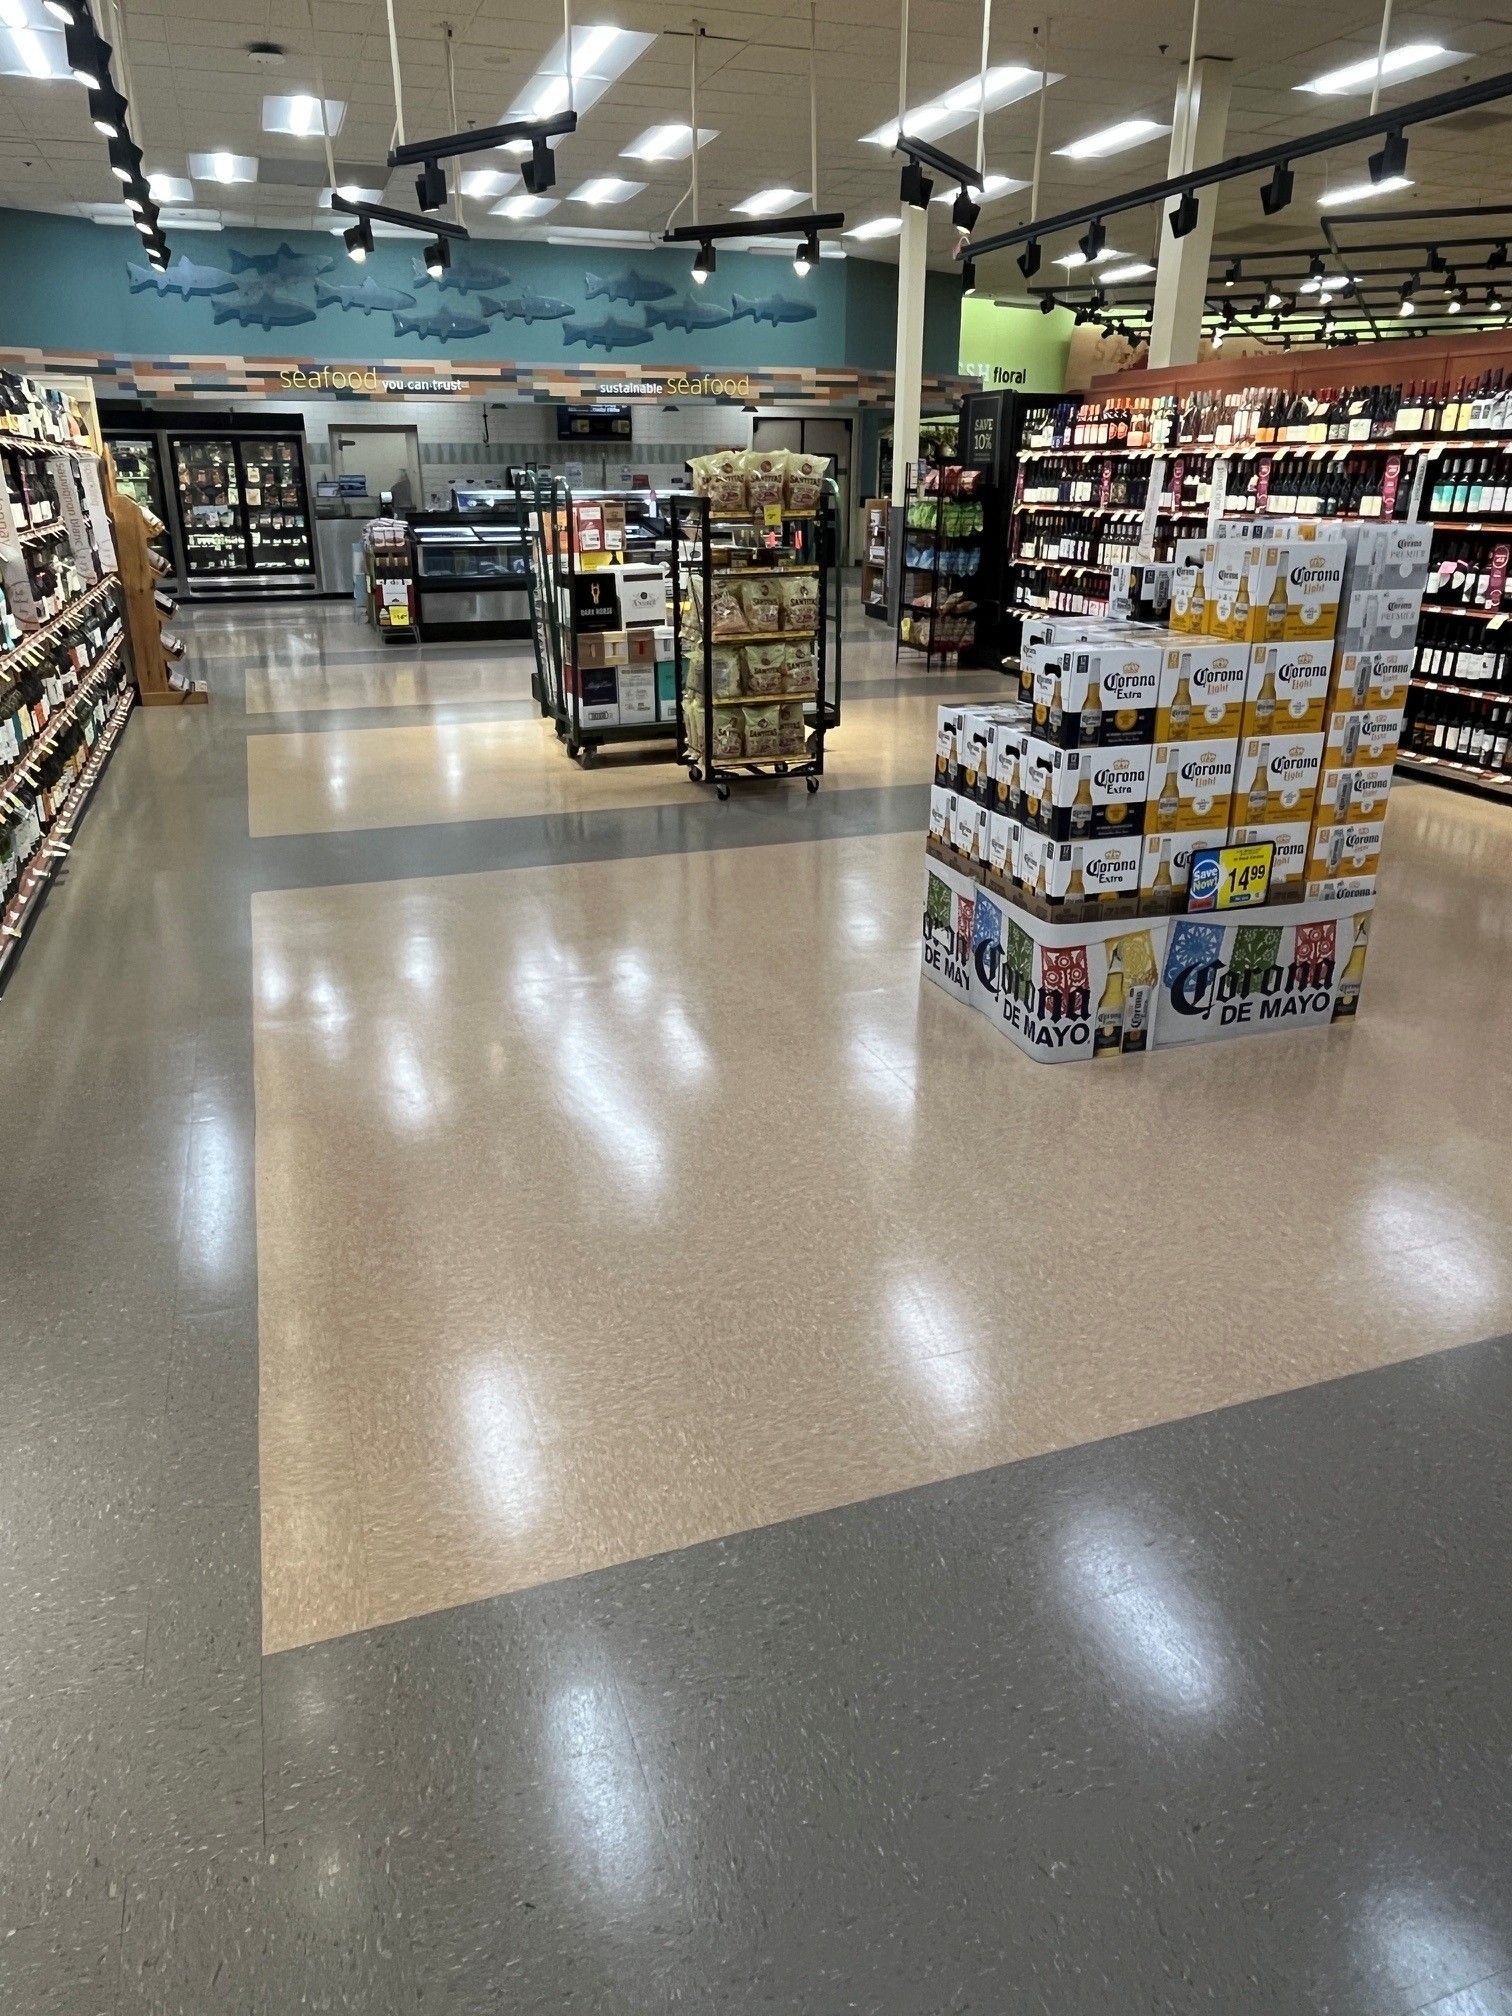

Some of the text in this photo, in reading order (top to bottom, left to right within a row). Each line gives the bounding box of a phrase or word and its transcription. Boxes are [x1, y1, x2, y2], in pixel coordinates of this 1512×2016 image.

[280, 366, 463, 392] seafood you can trust
[994, 367, 1026, 383] floral
[600, 374, 749, 396] sustainable seafood
[975, 418, 994, 431] SAVE
[974, 433, 992, 450] 10%
[56, 463, 84, 547] sauvignon blanc
[1290, 566, 1340, 586] Corona
[1303, 584, 1325, 594] Light
[1193, 667, 1243, 688] Corona
[1278, 663, 1327, 683] Corona
[1373, 661, 1408, 676] Corona
[1103, 672, 1155, 693] Corona
[1207, 683, 1229, 695] Light
[1292, 679, 1312, 690] Light
[1116, 689, 1142, 699] Extra
[1362, 722, 1398, 736] Corona
[1181, 761, 1232, 781] Corona
[1271, 755, 1318, 775] Corona
[1093, 770, 1145, 789] Corona
[1195, 776, 1217, 788] Light
[1283, 770, 1304, 782] Light
[1107, 784, 1132, 794] Extra
[1354, 779, 1387, 792] Corona
[1346, 834, 1379, 847] Corona
[1086, 859, 1136, 878] Corona
[1193, 867, 1219, 882] Save
[1099, 873, 1123, 884] Extra
[1336, 887, 1370, 900] Corona
[924, 943, 941, 971] DE
[974, 938, 1091, 1024] Corona
[1170, 957, 1336, 1020] Corona
[1130, 990, 1143, 1028] Corona
[1220, 991, 1331, 1026] DE MAYO
[1003, 998, 1090, 1047] DE MAYO
